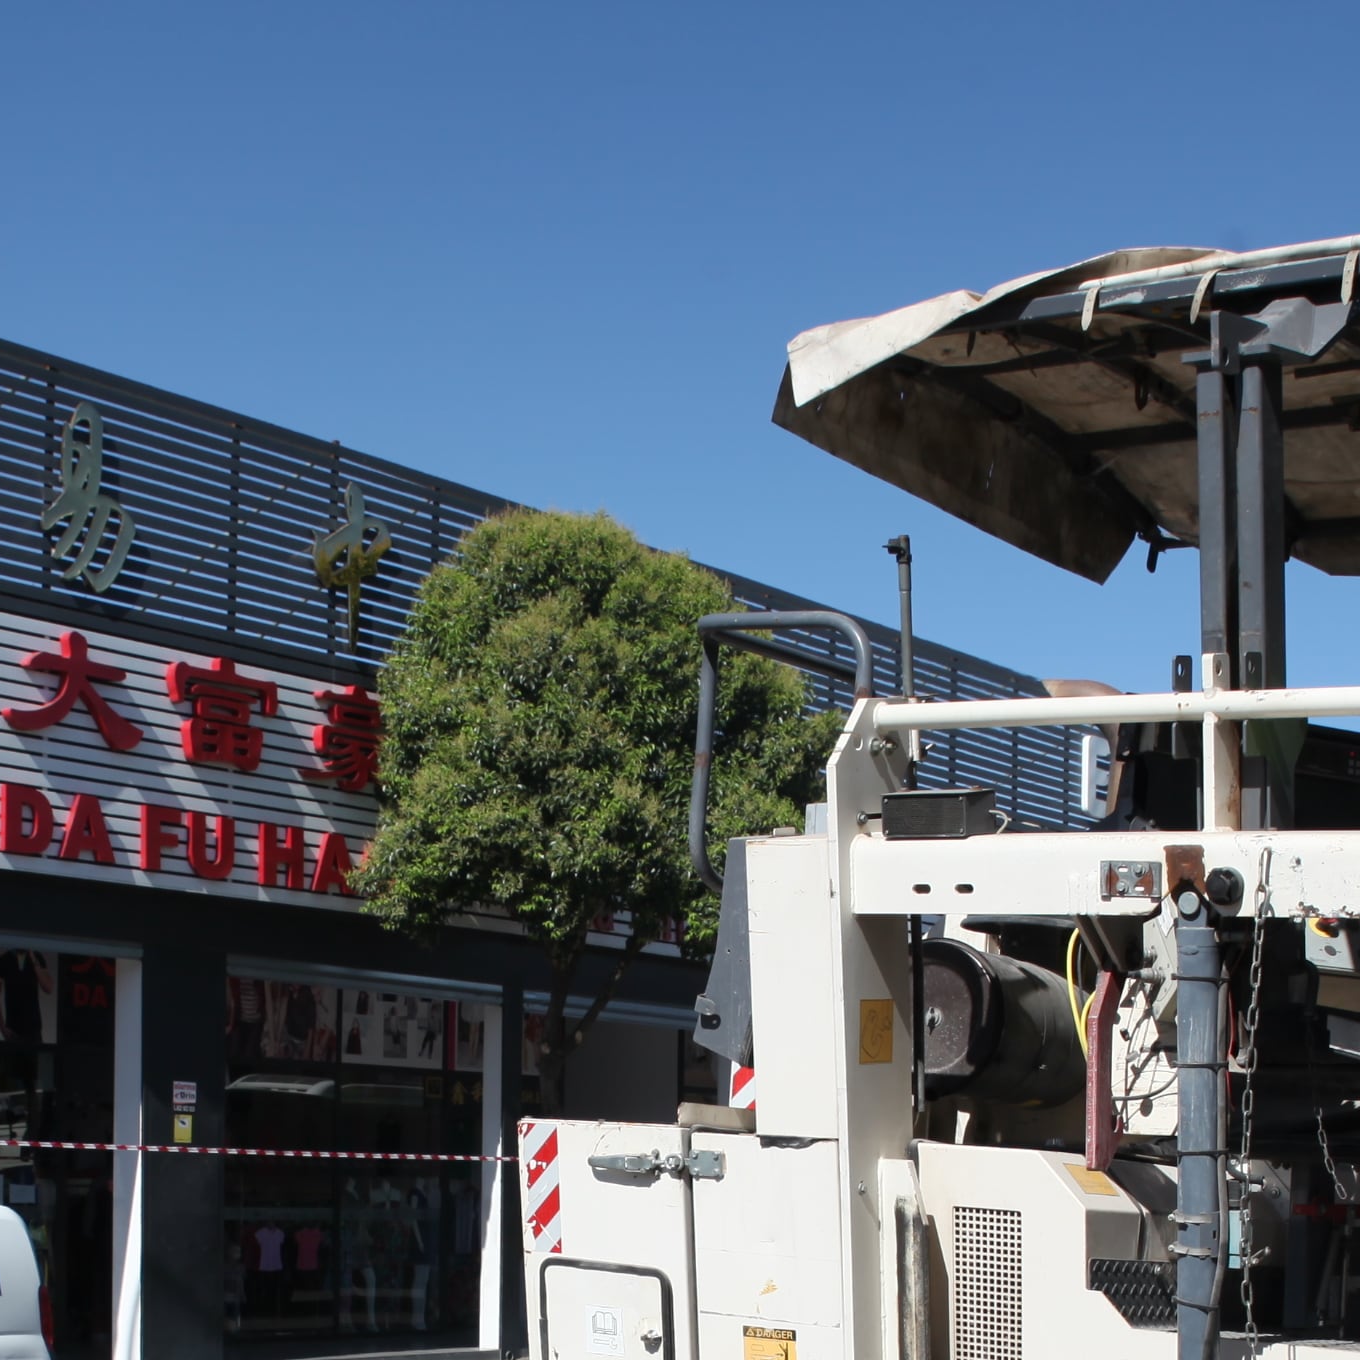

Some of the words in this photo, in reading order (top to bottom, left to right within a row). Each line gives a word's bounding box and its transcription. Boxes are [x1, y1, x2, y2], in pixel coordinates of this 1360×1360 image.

[0, 631, 382, 792] 大富豪
[0, 783, 115, 864] DA
[140, 803, 235, 880] FU
[755, 1327, 794, 1340] DANGER
